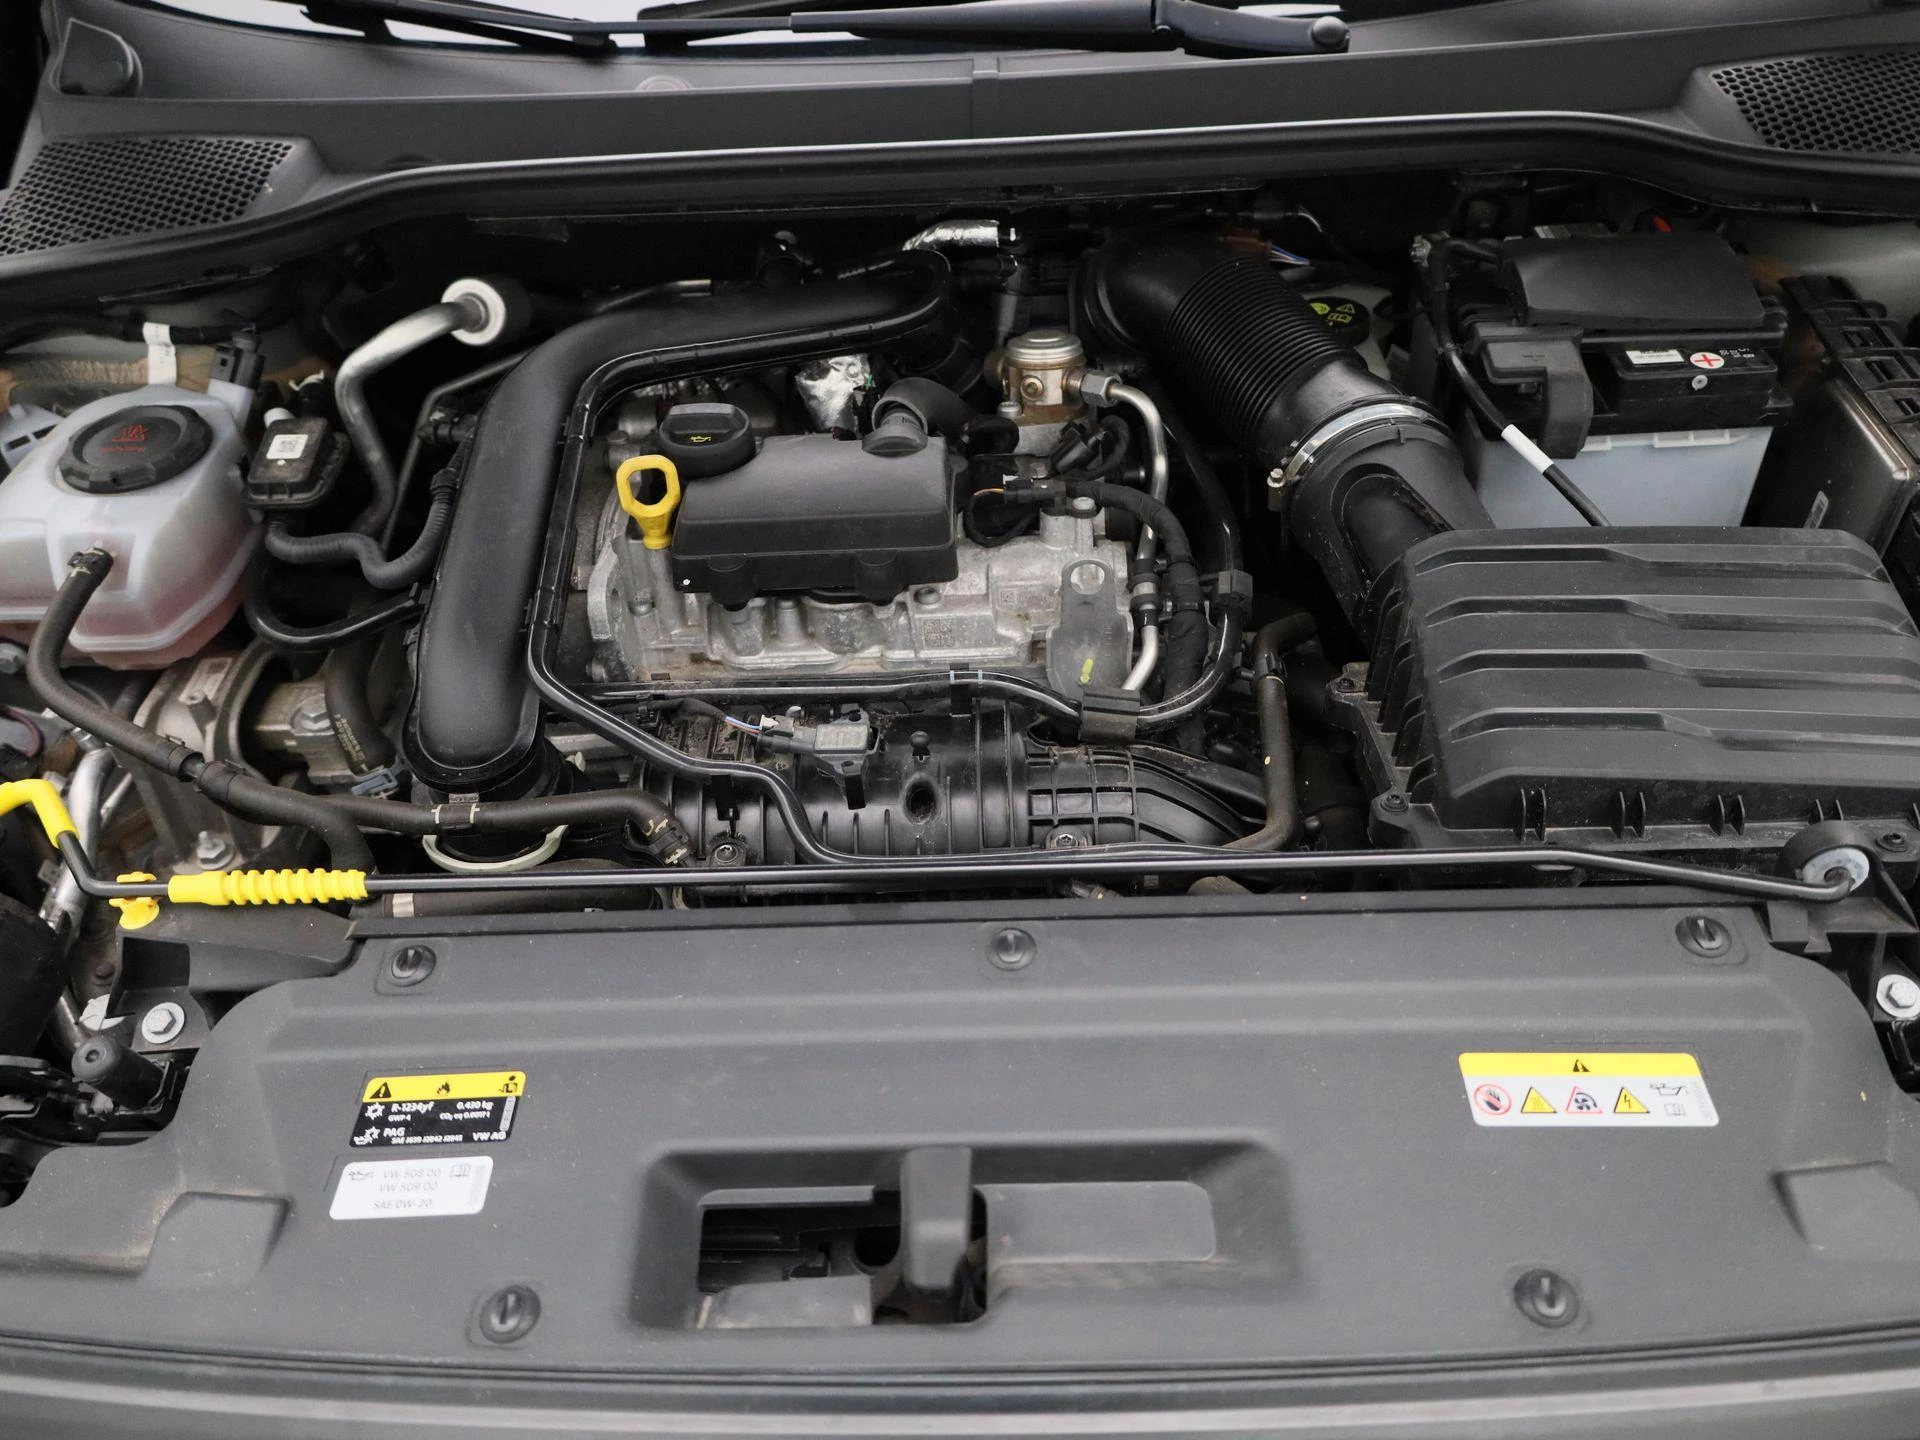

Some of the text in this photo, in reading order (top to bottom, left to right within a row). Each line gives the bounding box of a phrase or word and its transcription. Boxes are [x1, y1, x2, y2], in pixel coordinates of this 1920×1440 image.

[383, 1127, 405, 1138] PAG
[472, 1131, 507, 1141] VW AG
[383, 1169, 402, 1180] VW
[426, 1167, 442, 1178] 00
[380, 1183, 398, 1193] VW
[422, 1181, 439, 1192] 00
[373, 1200, 393, 1210] SAE
